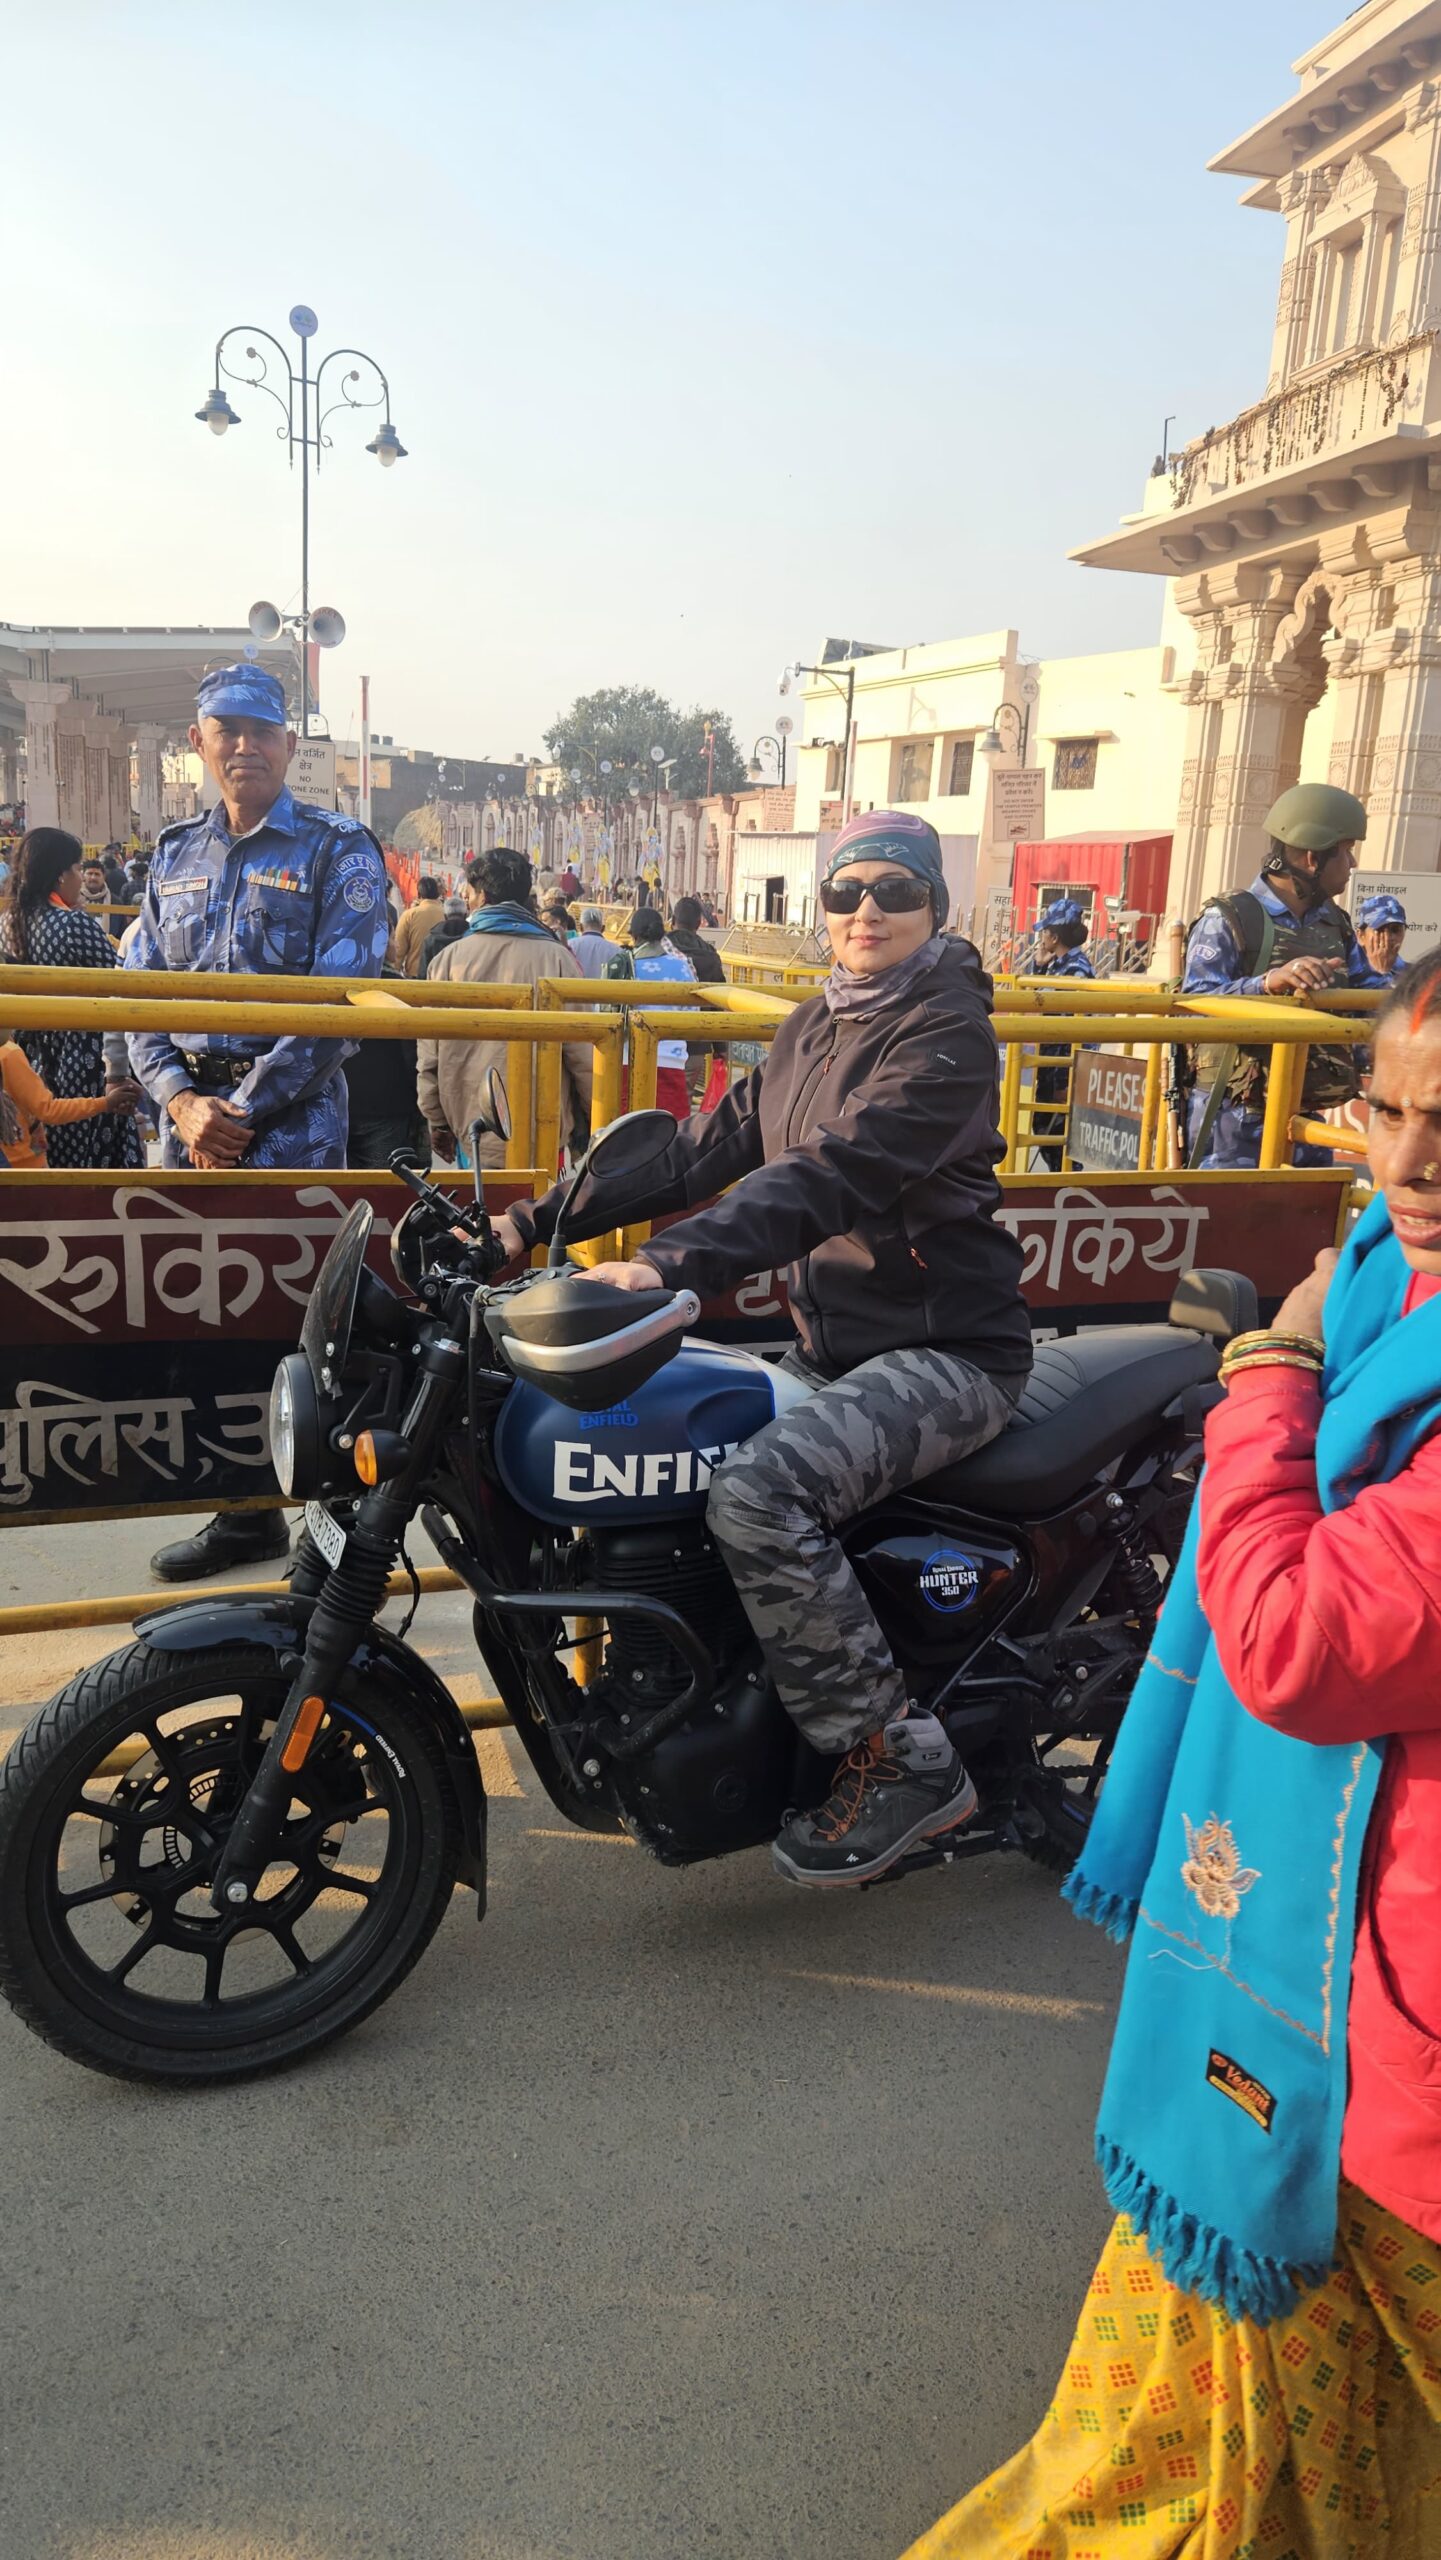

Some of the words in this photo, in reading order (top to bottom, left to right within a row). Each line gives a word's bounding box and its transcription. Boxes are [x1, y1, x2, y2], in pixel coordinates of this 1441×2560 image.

[309, 787, 330, 795] ZONE
[1087, 1068, 1141, 1112] PLEASE
[1080, 1121, 1119, 1156] TRAFFIC
[579, 1413, 640, 1431] ENFIELD
[920, 1570, 979, 1588] HUNTER
[941, 1585, 960, 1596] 350
